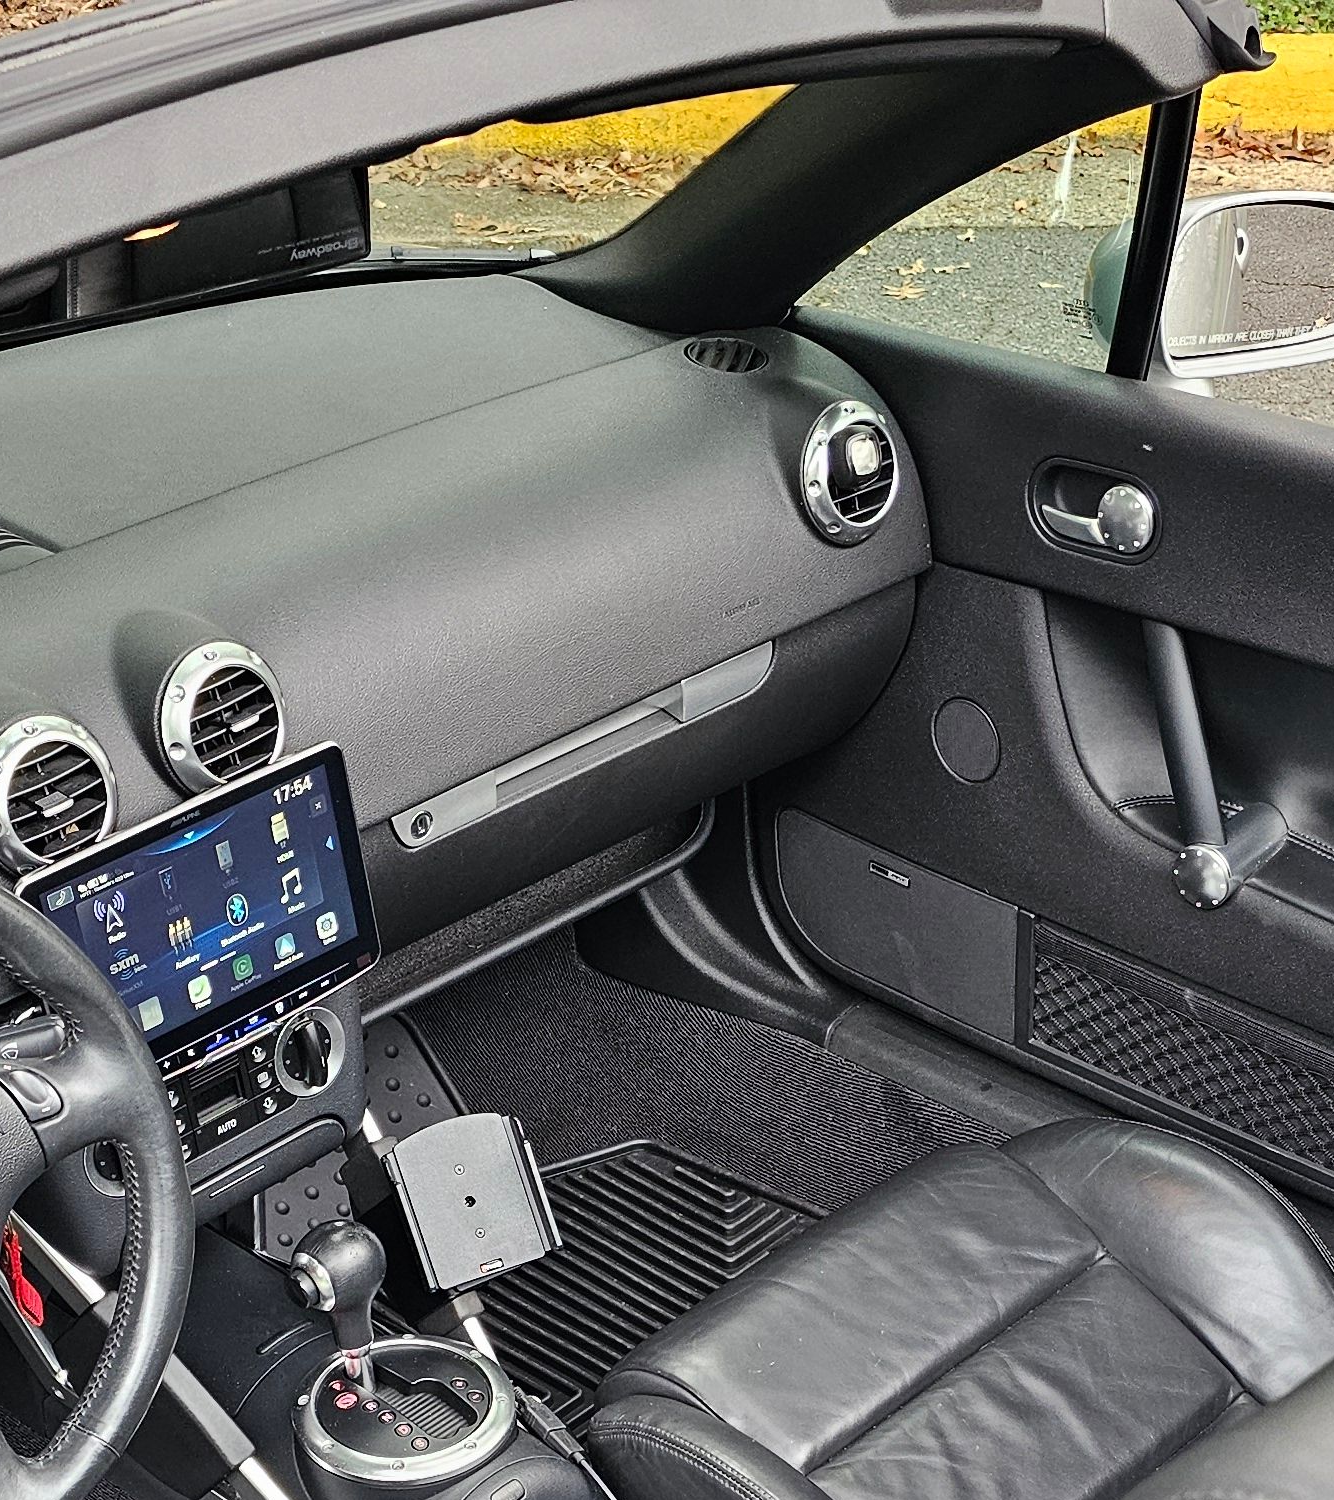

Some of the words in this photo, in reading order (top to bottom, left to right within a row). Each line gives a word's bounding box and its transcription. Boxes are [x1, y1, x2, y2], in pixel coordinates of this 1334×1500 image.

[289, 237, 359, 261] Broadway
[1167, 335, 1197, 347] OBJECTS
[1198, 334, 1207, 345] IN
[1208, 332, 1234, 345] MIRROR
[1234, 331, 1249, 343] ARE
[1249, 328, 1275, 342] CLOSER
[1276, 327, 1293, 338] THAN
[273, 775, 313, 804] 17:54
[109, 953, 140, 975] sxm
[217, 1119, 237, 1135] AUTO
